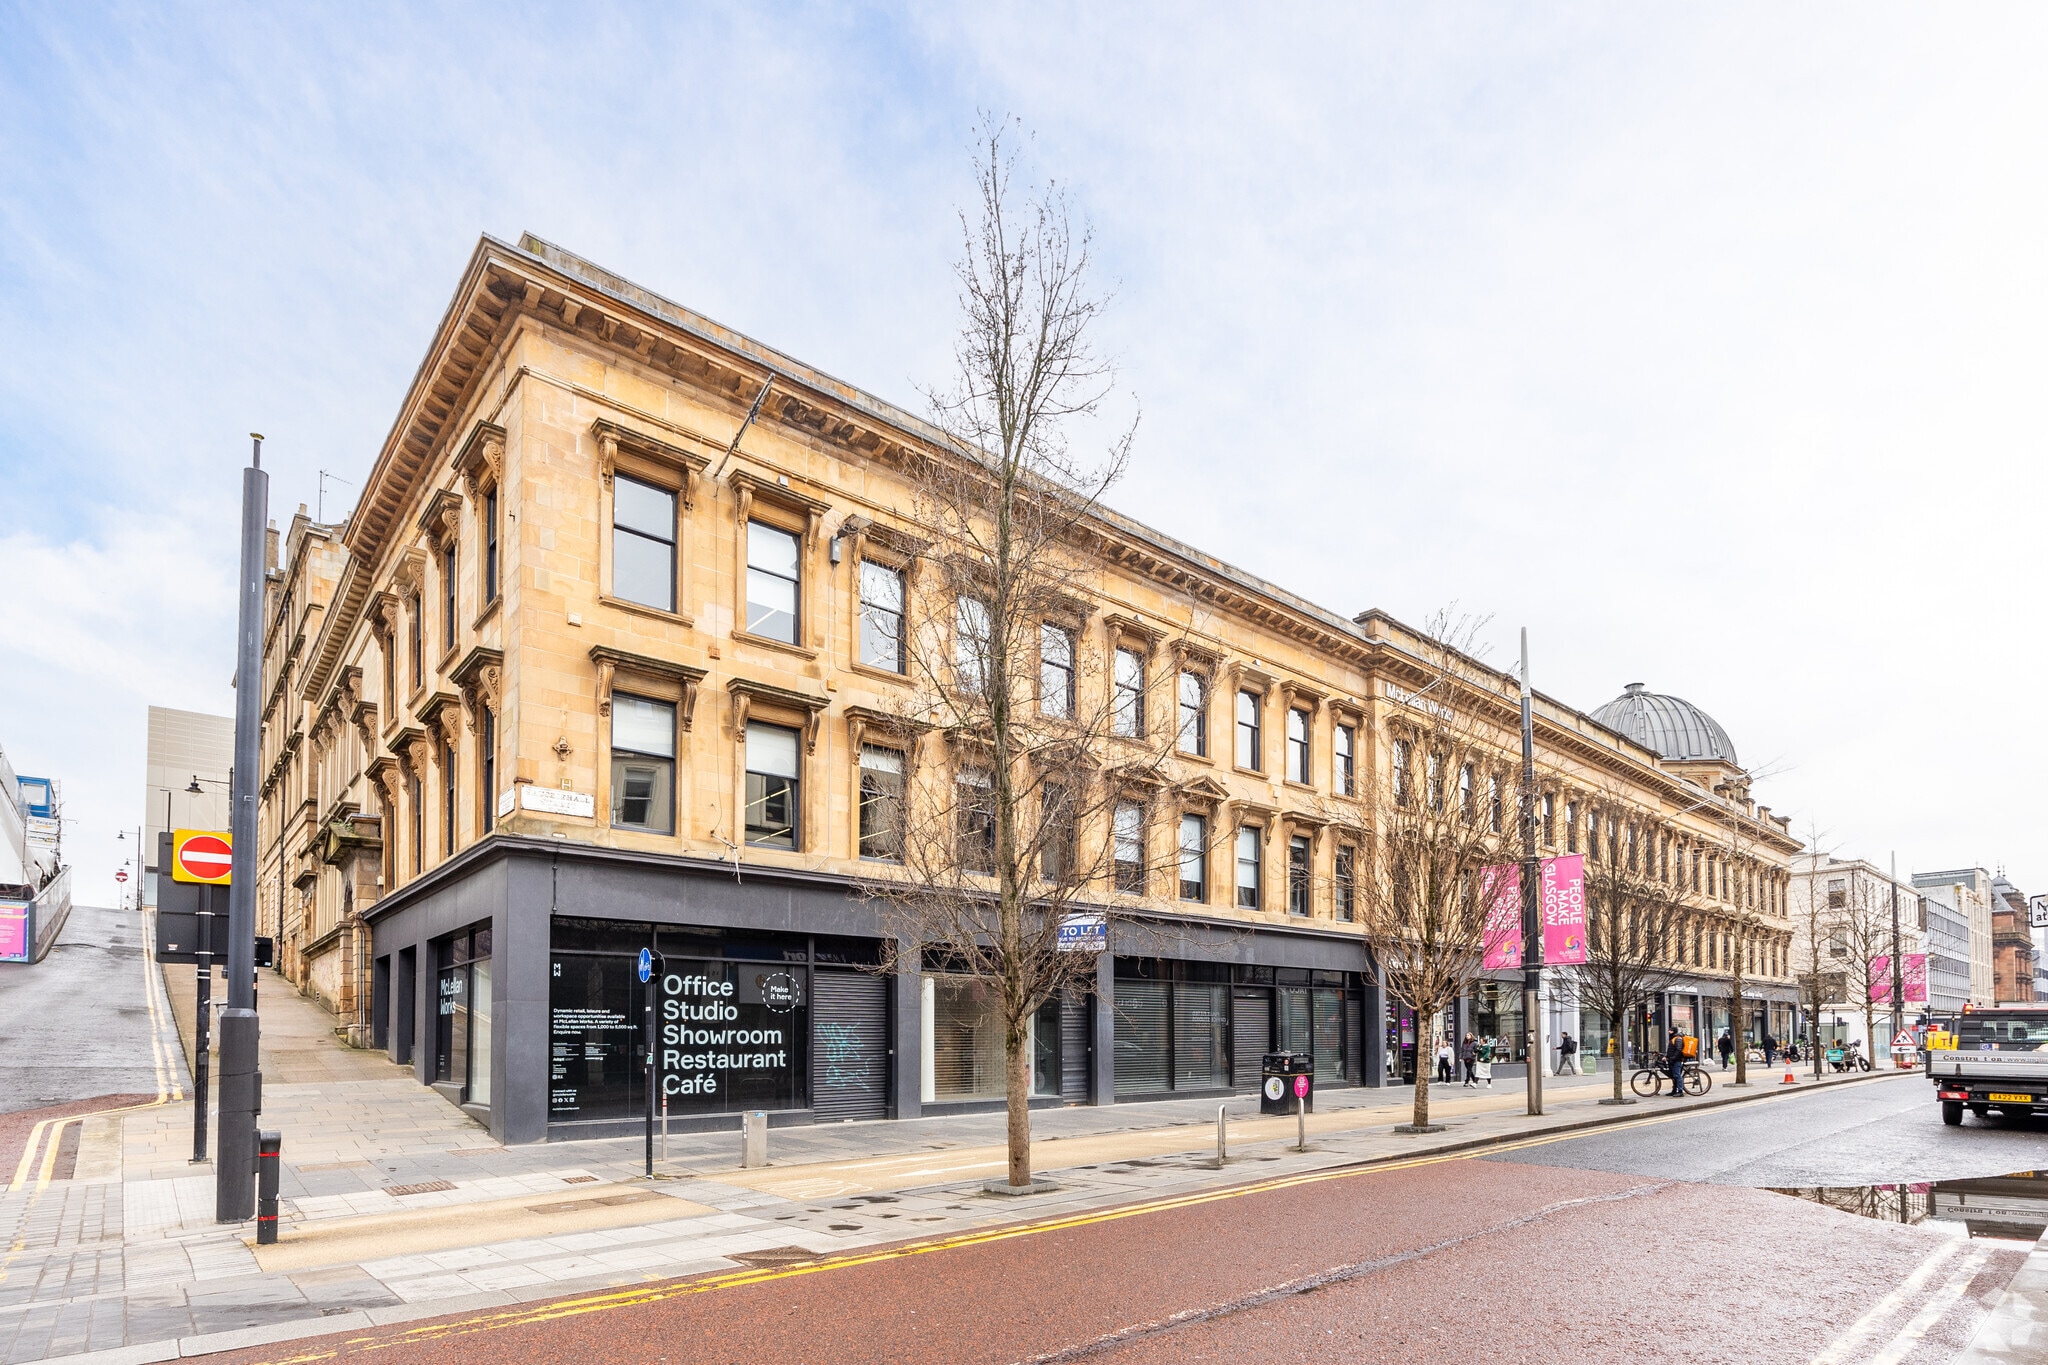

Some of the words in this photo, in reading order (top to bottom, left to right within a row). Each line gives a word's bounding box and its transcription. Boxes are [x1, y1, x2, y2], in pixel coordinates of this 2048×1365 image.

[1545, 863, 1558, 926] GLASGOW
[1569, 878, 1582, 925] PEOPLE
[1557, 890, 1570, 925] MAKE
[1062, 927, 1077, 936] TO
[663, 974, 734, 997] Office
[770, 985, 789, 993] Make
[663, 999, 738, 1021] Studio
[663, 1024, 782, 1045] Showroom
[663, 1049, 786, 1070] Restaurant
[662, 1073, 717, 1095] Café
